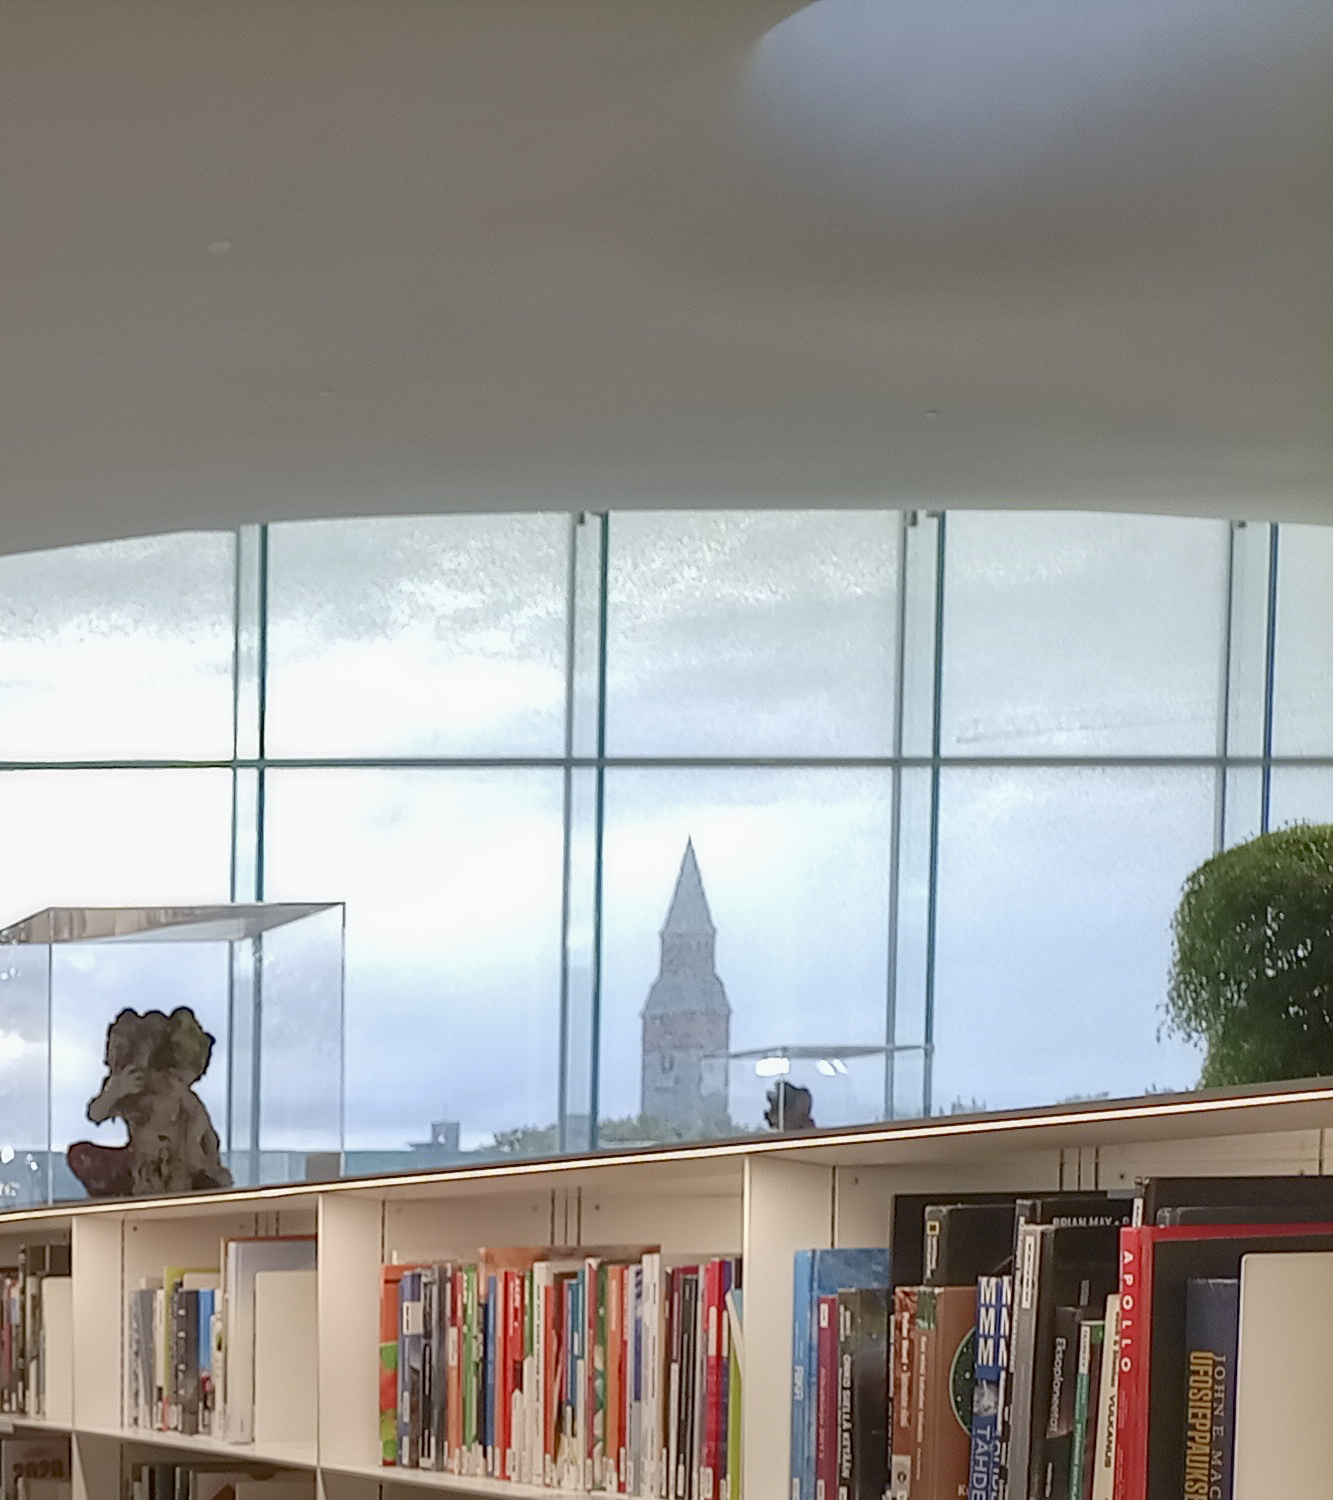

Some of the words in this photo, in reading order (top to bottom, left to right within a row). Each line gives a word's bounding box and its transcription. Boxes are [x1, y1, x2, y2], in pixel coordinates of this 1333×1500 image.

[1120, 1250, 1134, 1373] APOLLO
[1214, 1354, 1227, 1415] JOHN
[1104, 1394, 1116, 1469] VULKANUS
